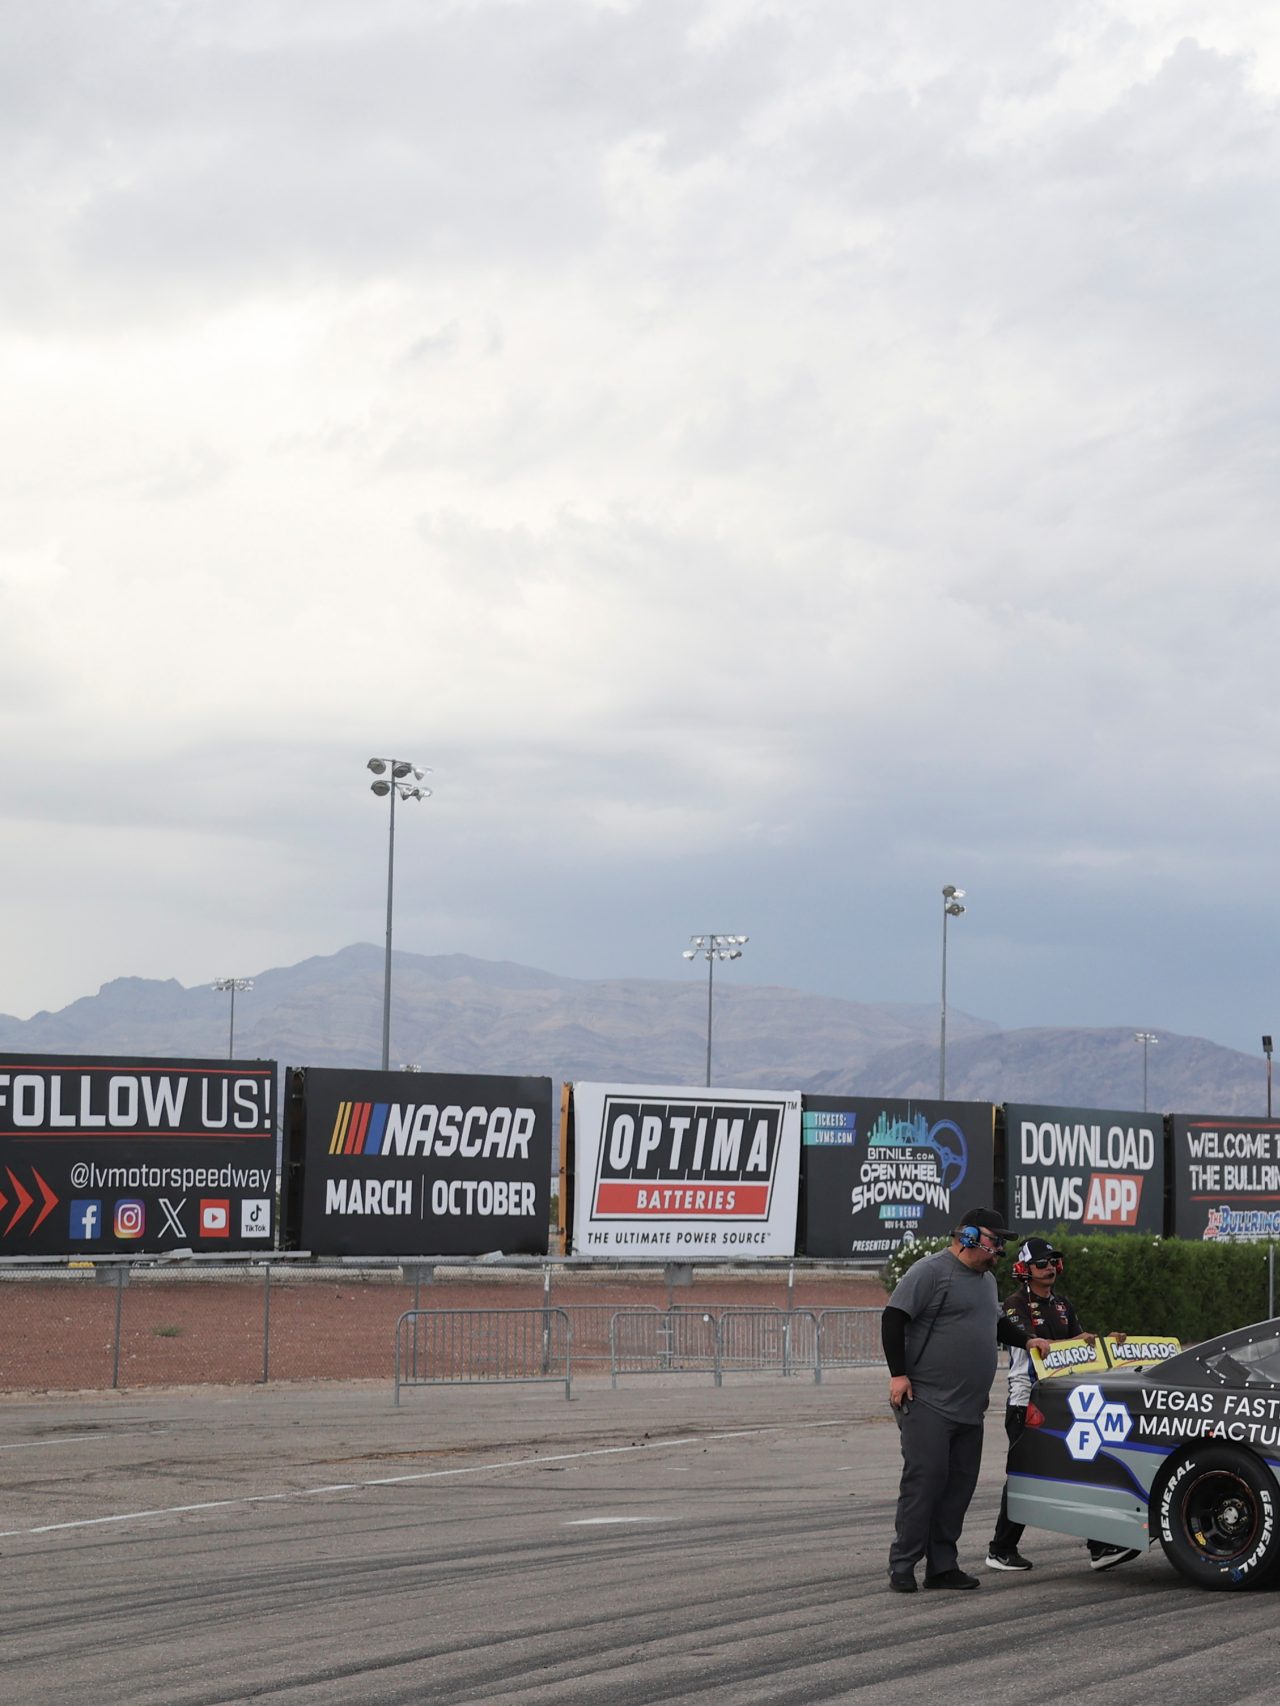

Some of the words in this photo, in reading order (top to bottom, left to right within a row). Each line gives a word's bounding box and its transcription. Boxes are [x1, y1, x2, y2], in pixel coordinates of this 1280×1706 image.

[202, 1077, 271, 1129] US!
[381, 1103, 536, 1159] NASCAR
[814, 1112, 847, 1126] TICKETS:
[608, 1113, 768, 1172] OPTIMA
[815, 1130, 853, 1144] LVMS.COM
[1020, 1121, 1155, 1170] DOWNLOAD
[1187, 1132, 1271, 1159] WELCOME
[70, 1162, 272, 1192] @lvmotorspeedway
[860, 1163, 897, 1183] OPEN
[899, 1163, 942, 1184] WHEEL
[1189, 1165, 1221, 1190] THE
[325, 1179, 412, 1215] MARCH
[431, 1179, 536, 1216] OCTOBER
[636, 1190, 736, 1210] BATTERIES
[851, 1180, 950, 1215] SHOWDOWN
[1021, 1175, 1084, 1220] LVMS
[1087, 1178, 1138, 1221] APP
[883, 1205, 896, 1217] LAS
[900, 1205, 921, 1218] VEGAS
[245, 1224, 267, 1233] TikTok
[884, 1220, 894, 1229] NOV
[906, 1220, 918, 1229] 2025
[587, 1232, 609, 1244] THE
[615, 1232, 671, 1244] ULTIMATE
[676, 1232, 717, 1244] POWER
[852, 1240, 891, 1252] PRESENTED
[891, 1239, 902, 1251] BY
[1043, 1345, 1097, 1370] MENARDS
[1110, 1343, 1178, 1360] MENARDS
[1077, 1391, 1095, 1412] V
[1141, 1389, 1214, 1413] VEGAS
[1104, 1413, 1124, 1433] M
[1079, 1431, 1090, 1450] F
[1160, 1459, 1196, 1542] GENERAL
[1237, 1490, 1275, 1573] GENERAL
